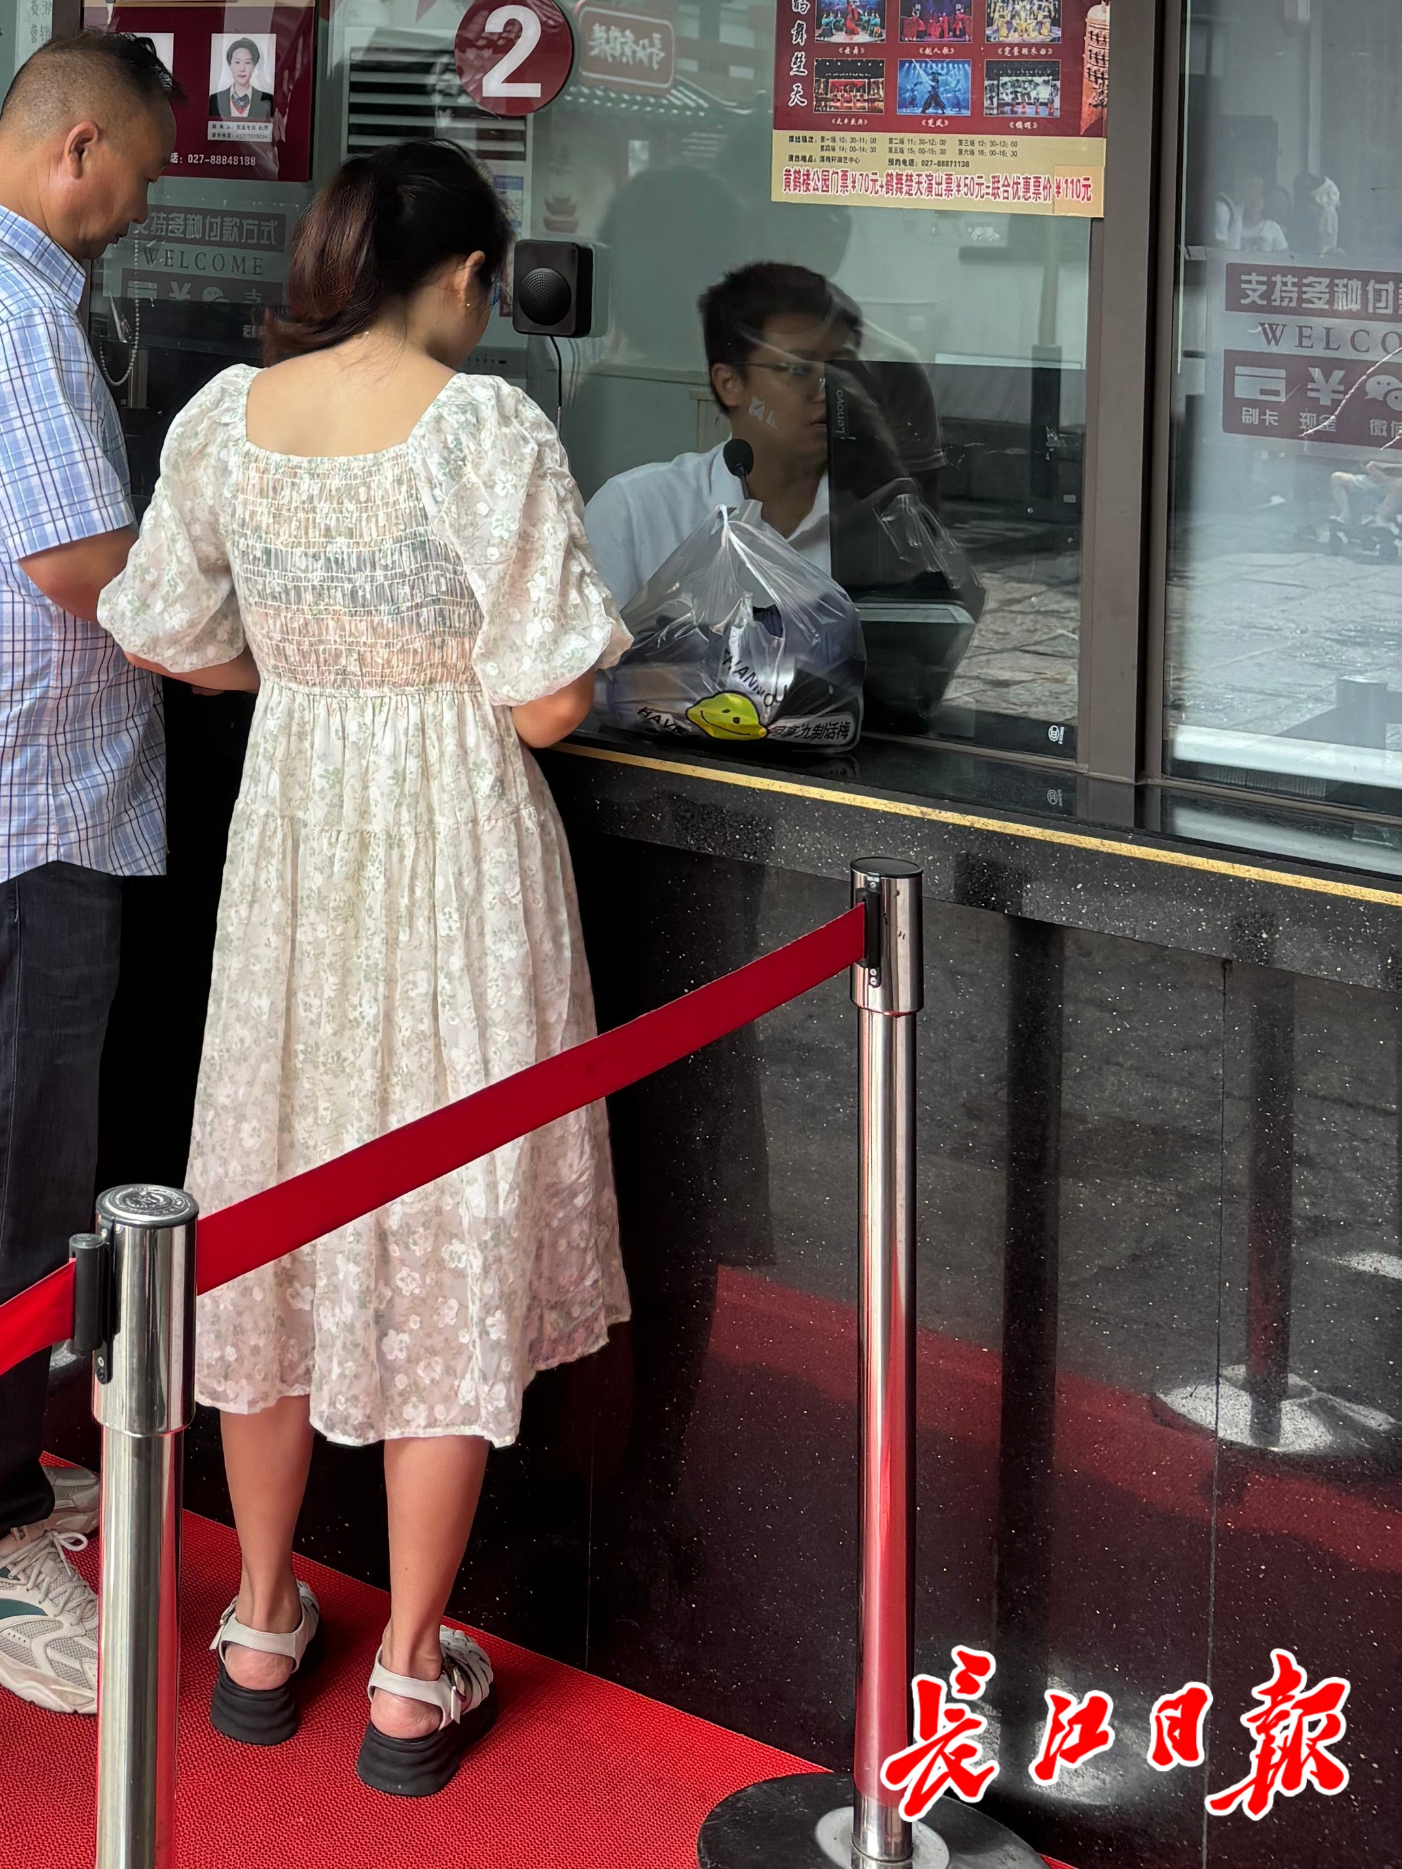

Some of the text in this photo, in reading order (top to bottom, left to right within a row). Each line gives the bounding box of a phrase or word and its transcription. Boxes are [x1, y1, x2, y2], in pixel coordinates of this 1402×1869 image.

[482, 4, 542, 98] 2
[144, 246, 263, 276] WELCOME
[1240, 272, 1402, 315] 支持多种付
[835, 390, 845, 434] Lenovo
[1242, 406, 1279, 427] 刷卡
